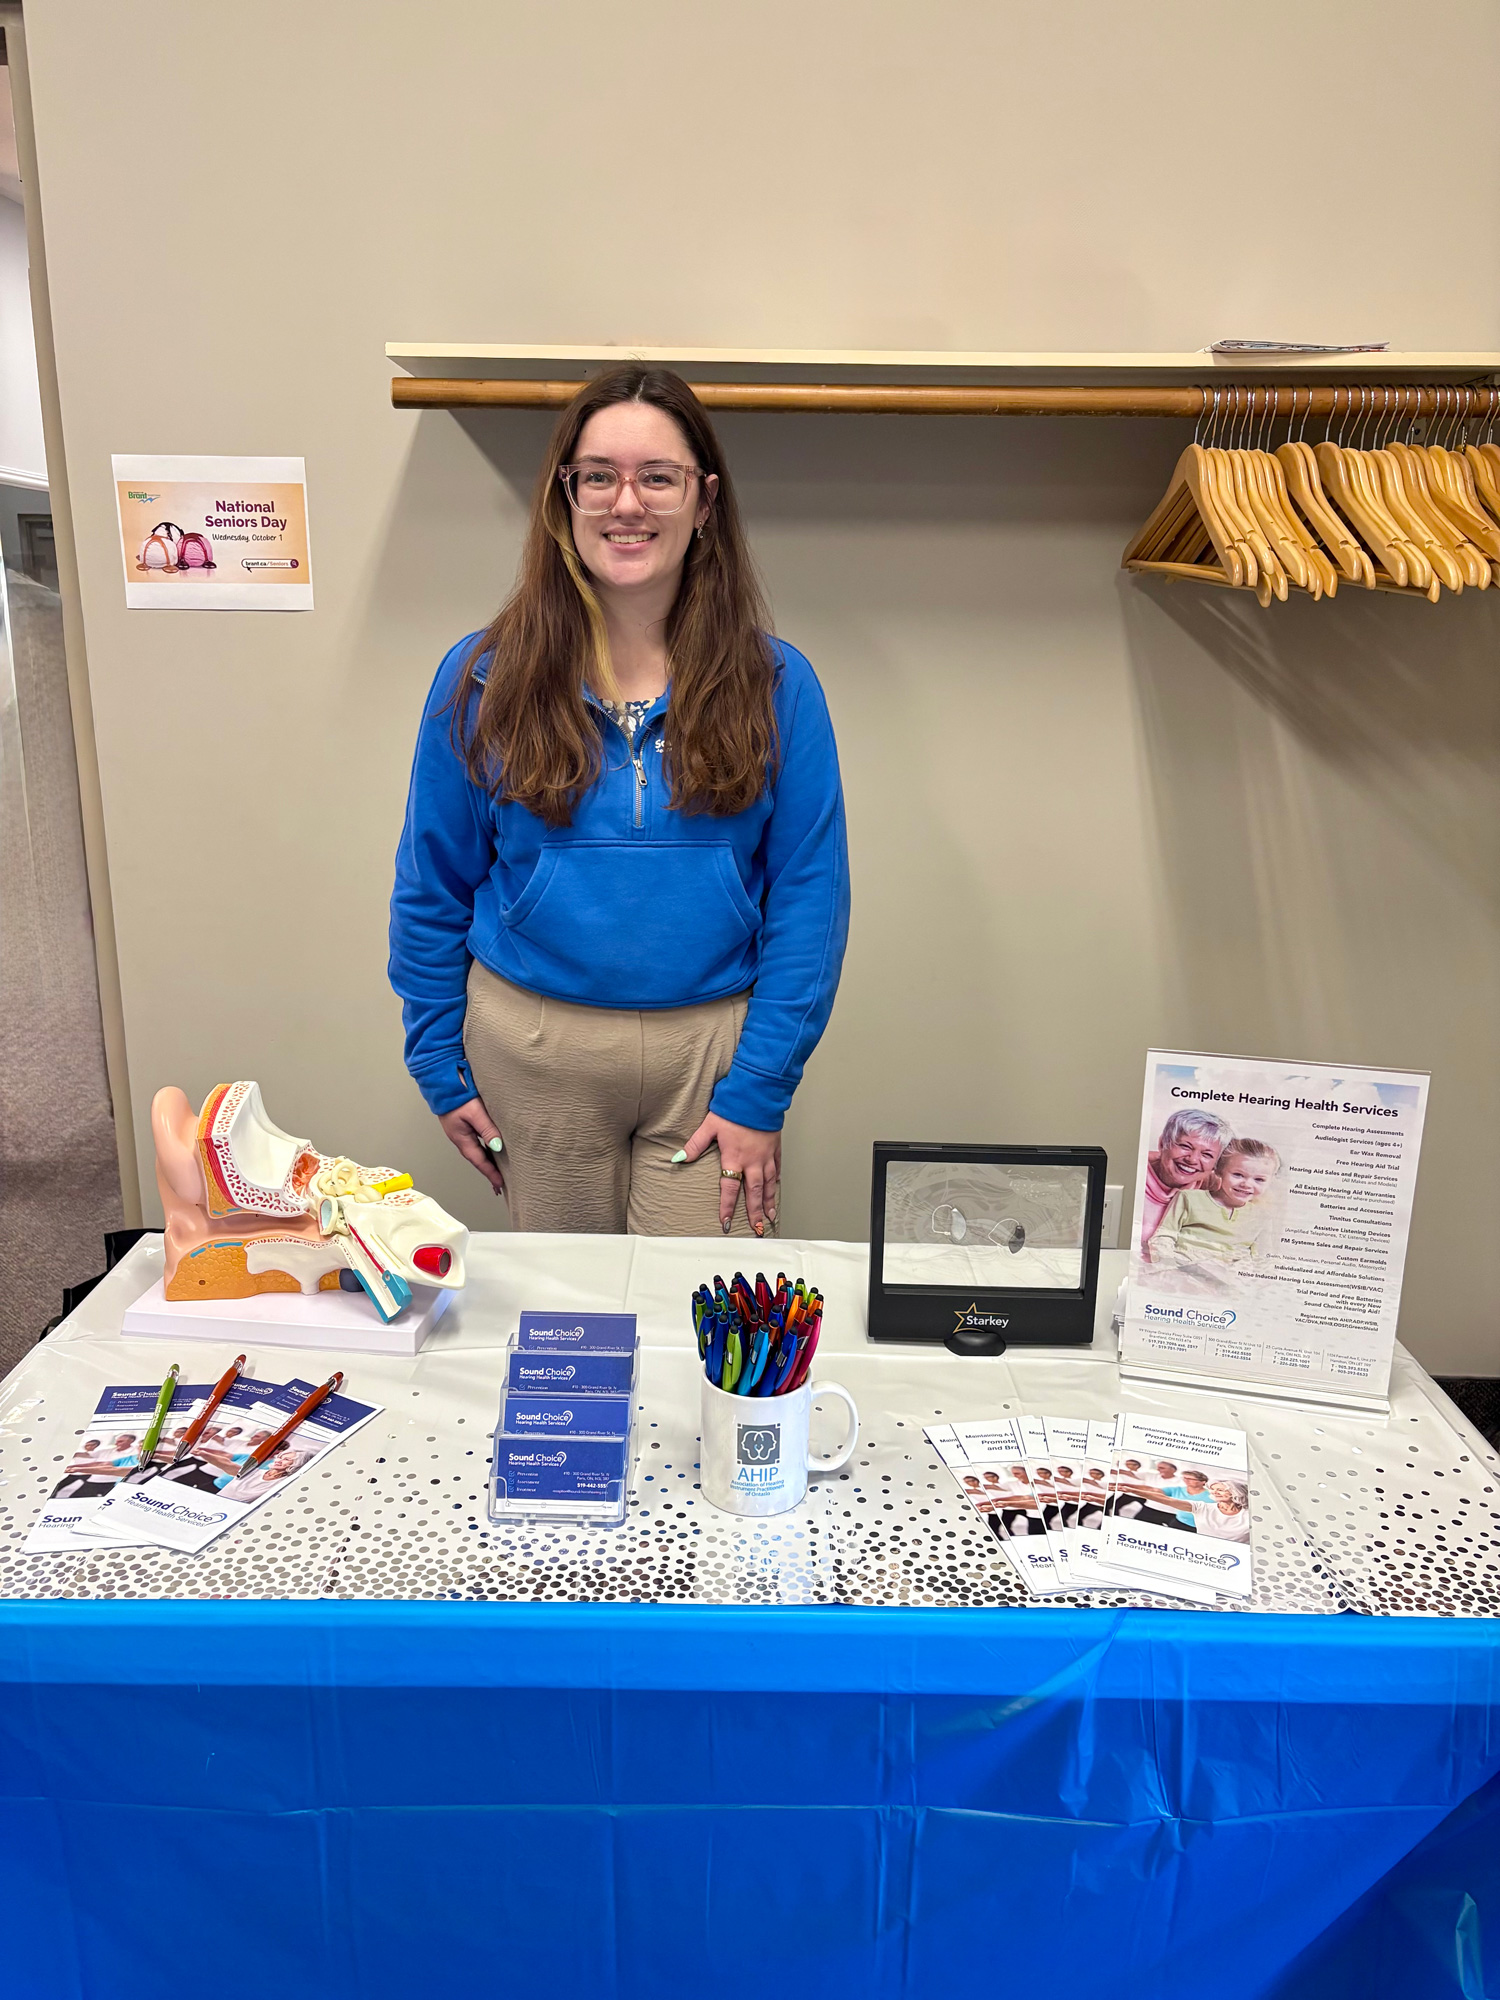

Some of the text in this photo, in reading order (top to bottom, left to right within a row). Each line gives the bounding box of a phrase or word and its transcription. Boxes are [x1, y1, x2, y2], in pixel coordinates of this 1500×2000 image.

[128, 491, 147, 499] Brant
[215, 500, 274, 513] National
[205, 515, 287, 531] Seniors Day
[212, 534, 249, 542] Wednesday,
[1170, 1086, 1399, 1117] Complete Hearing Health Services
[1311, 1123, 1340, 1131] Complete
[1366, 1128, 1404, 1136] Assessments
[1314, 1134, 1348, 1143] Audiologist
[1289, 1166, 1312, 1174] Hearing
[1353, 1172, 1372, 1180] Repair
[1303, 1184, 1327, 1192] Existing
[1328, 1187, 1351, 1195] Hearing
[1359, 1207, 1393, 1215] Accessories
[1352, 1217, 1392, 1226] Consultations
[1340, 1228, 1366, 1236] Listening
[1291, 1239, 1315, 1247] Systems
[1359, 1257, 1387, 1265] Earmolds
[1274, 1264, 1313, 1273] Individualized
[1326, 1270, 1357, 1278] Affordable
[1278, 1276, 1301, 1284] Hearing
[1144, 1303, 1227, 1323] Sound Choice
[1343, 1305, 1366, 1313] Hearing
[966, 1316, 1009, 1328] Starkey
[1143, 1314, 1170, 1323] Hearing
[1196, 1320, 1226, 1329] Services
[546, 1368, 571, 1376] Choice
[542, 1413, 568, 1421] Choice
[1132, 1425, 1172, 1436] Maintaining
[1180, 1433, 1206, 1441] Healthy
[1207, 1438, 1236, 1446] Lifestyle
[1145, 1433, 1222, 1451] Promotes Hearing
[1166, 1442, 1188, 1451] Brain
[1191, 1447, 1220, 1456] Health
[508, 1453, 562, 1462] Sound Choice
[738, 1467, 778, 1482] AHIP
[124, 1498, 151, 1513] Hearing
[152, 1507, 176, 1519] Health
[175, 1515, 205, 1528] Services
[132, 1492, 173, 1510] Sound
[172, 1506, 212, 1522] Choice
[42, 1515, 82, 1523] Soun
[1117, 1533, 1227, 1565] Sound Choice
[1116, 1541, 1226, 1571] Hearing Health Services
